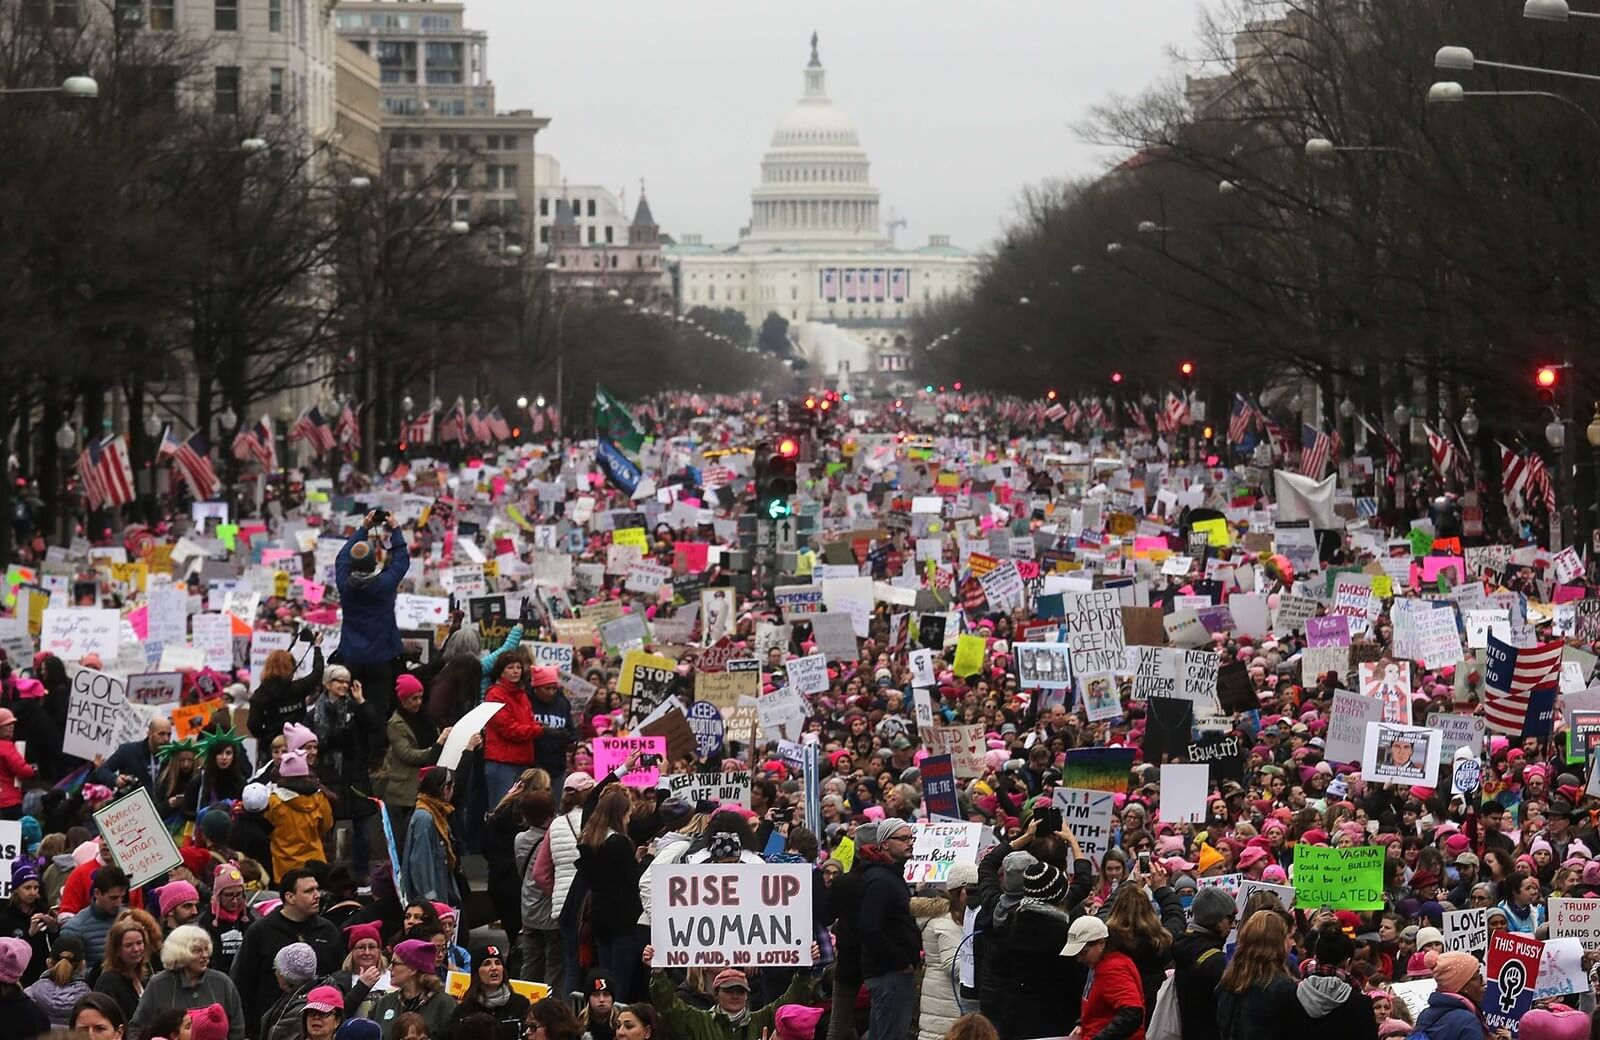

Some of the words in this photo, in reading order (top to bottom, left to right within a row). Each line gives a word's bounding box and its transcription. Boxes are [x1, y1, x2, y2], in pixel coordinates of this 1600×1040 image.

[1338, 583, 1372, 597] DIVERSITY
[775, 592, 822, 605] STRONGER
[1076, 591, 1113, 612] KEEP
[1334, 603, 1368, 619] AMERICA
[1065, 608, 1123, 633] RAPISTS
[1315, 618, 1337, 630] Yes
[1073, 633, 1101, 651] OFF
[1104, 630, 1124, 651] MY
[533, 645, 571, 661] TCHES
[1073, 648, 1128, 674] CAMPUS
[1140, 647, 1162, 664] WE
[1184, 651, 1219, 668] NEVER
[1487, 646, 1506, 662] ITED
[695, 656, 730, 667] VIOLE
[635, 666, 675, 683] STOP
[1137, 664, 1160, 676] ARE
[75, 669, 125, 706] GOD
[1136, 677, 1175, 691] CITIZENS
[1185, 680, 1215, 698] BACK
[1134, 688, 1172, 699] UNITED
[691, 702, 716, 718] KEEP
[737, 707, 755, 718] MY
[688, 718, 723, 735] BORTION
[1440, 720, 1449, 730] MY
[1452, 721, 1469, 731] BODY
[968, 727, 983, 741] WE
[603, 740, 655, 750] WOMENS
[696, 733, 719, 752] EGAL
[1187, 736, 1238, 762] EQUALITY
[1461, 762, 1477, 770] KEEP
[670, 774, 695, 792] KEEP
[696, 774, 722, 787] YOUR
[725, 772, 751, 788] LAWS
[939, 780, 951, 793] THE
[691, 788, 711, 801] OFF
[719, 787, 740, 800] OUR
[103, 801, 142, 828] Women's
[1066, 805, 1089, 818] I'M
[119, 837, 156, 862] Human
[1077, 841, 1096, 853] ER
[1338, 850, 1378, 859] VAGINA
[1348, 861, 1382, 870] BULLETS
[668, 875, 740, 907] RISE
[761, 875, 801, 906] UP
[1295, 889, 1378, 903] REGULATED
[1564, 902, 1597, 911] TRUMP
[1451, 910, 1485, 932] LOVE
[1569, 914, 1590, 923] GOP
[668, 914, 802, 947] WOMAN.
[1557, 929, 1589, 938] HANDS
[1445, 935, 1466, 951] NOT
[1469, 930, 1486, 946] HATE
[1495, 937, 1514, 951] THIS
[1516, 942, 1542, 959] PUSSY
[667, 951, 690, 966] NO
[695, 951, 730, 966] MUD,
[733, 951, 751, 965] NO
[757, 950, 800, 965] LOTUS
[1483, 1015, 1504, 1027] RABS
[1505, 1019, 1520, 1032] BAC
